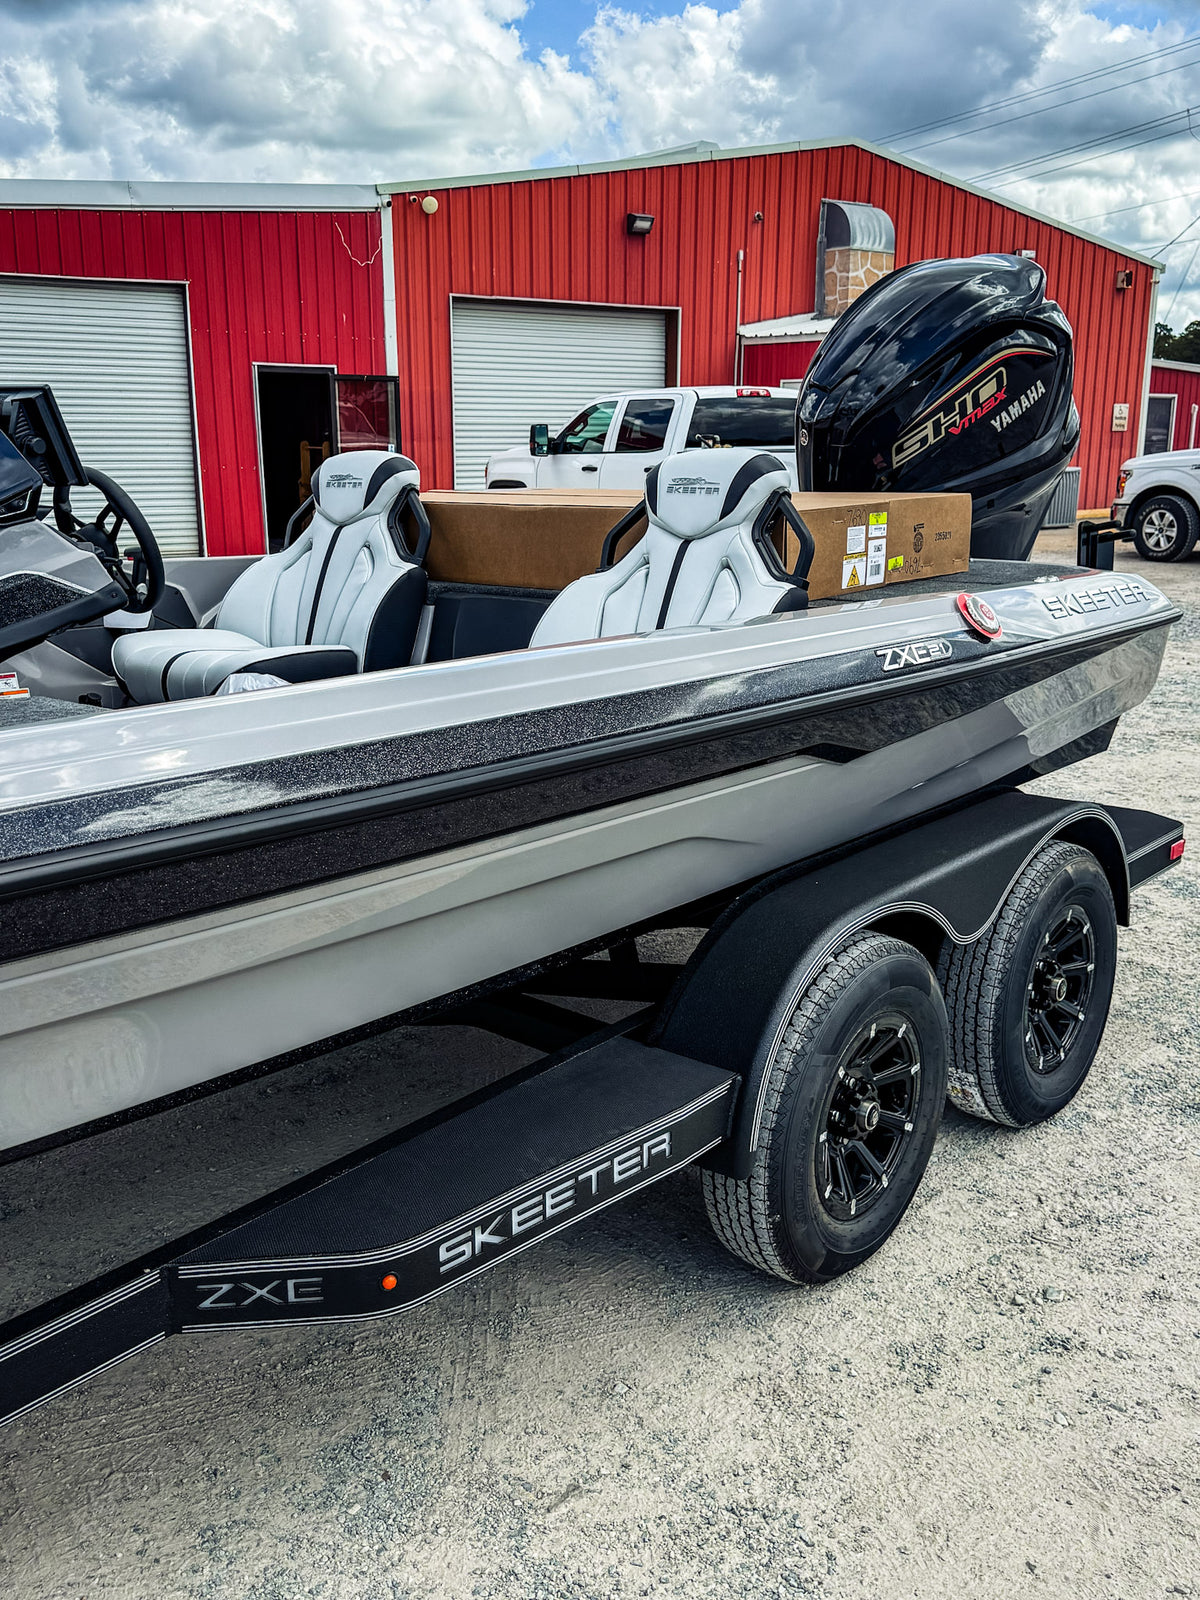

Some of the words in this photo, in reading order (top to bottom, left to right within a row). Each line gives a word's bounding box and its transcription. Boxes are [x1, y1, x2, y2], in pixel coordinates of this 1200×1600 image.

[990, 379, 1046, 433] YAMAHA
[325, 481, 363, 489] SKEETER
[666, 486, 720, 495] SKEETER
[1042, 583, 1151, 619] SKEETER
[438, 1131, 673, 1274] SKEETER
[196, 1277, 324, 1310] ZXE
